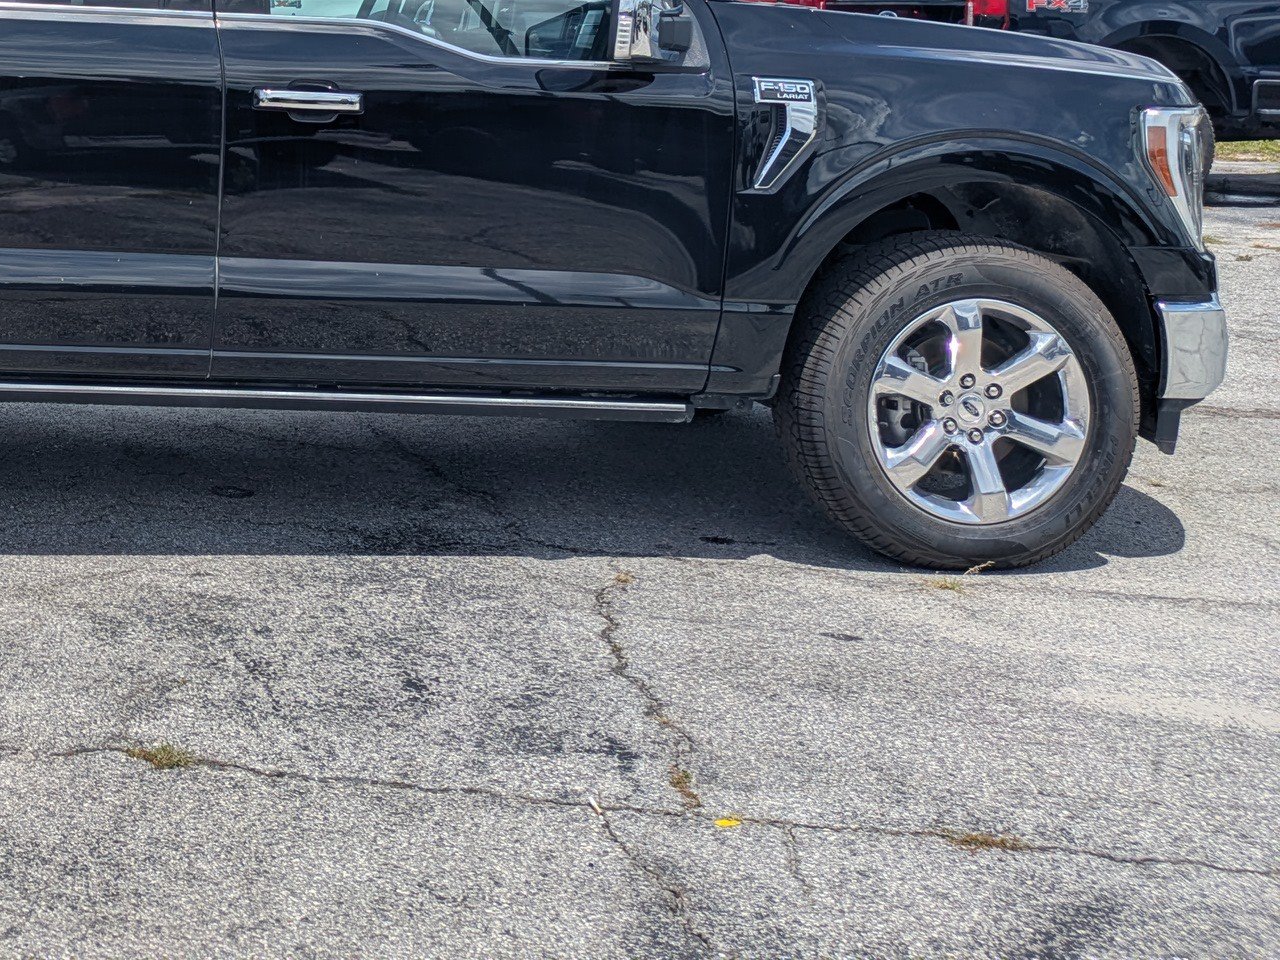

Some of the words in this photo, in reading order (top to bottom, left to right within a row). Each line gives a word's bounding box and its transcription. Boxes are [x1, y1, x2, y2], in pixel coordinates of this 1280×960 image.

[760, 81, 810, 93] F-150
[841, 297, 905, 426] SCORPION
[915, 273, 963, 300] ATR
